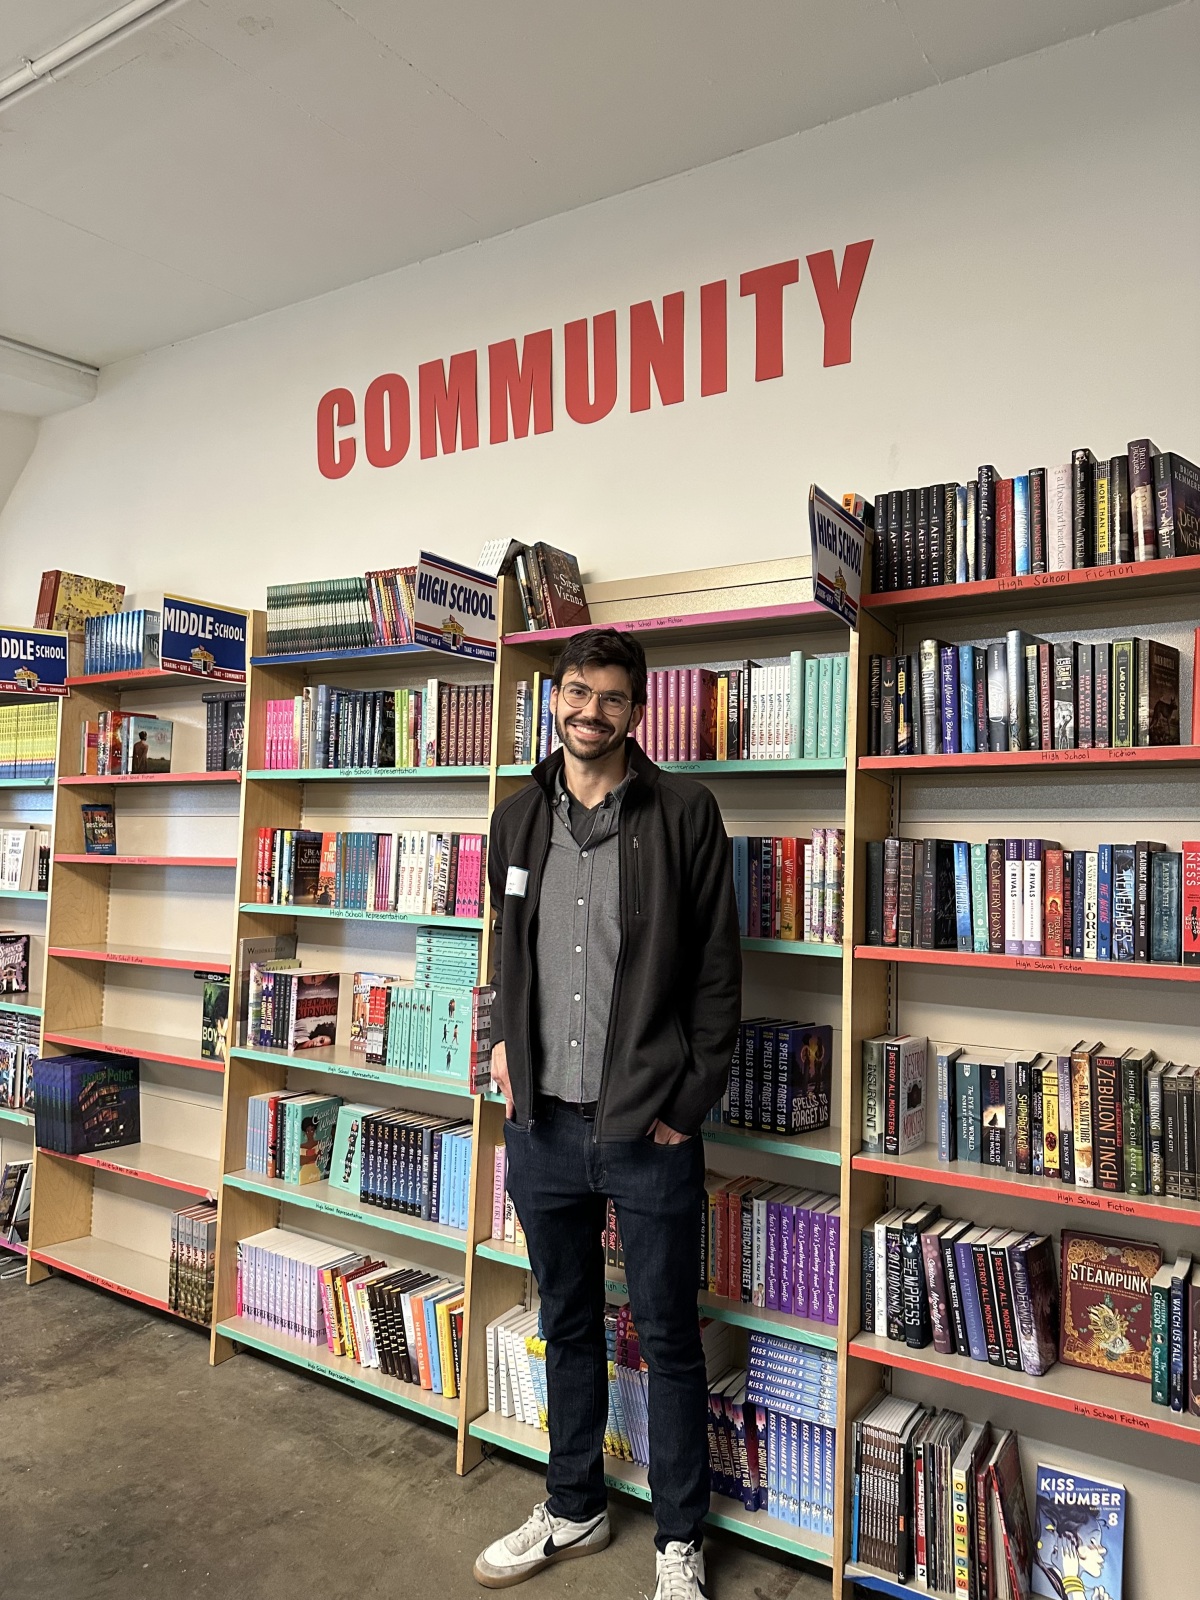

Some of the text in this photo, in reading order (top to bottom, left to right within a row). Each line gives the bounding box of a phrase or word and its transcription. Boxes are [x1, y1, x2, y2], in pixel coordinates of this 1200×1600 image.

[317, 239, 874, 479] COMMUNITY
[1033, 477, 1041, 509] DESTROY
[1174, 471, 1200, 491] KEMMERE
[1057, 482, 1066, 524] thousand
[817, 511, 837, 556] HIGH
[1057, 525, 1066, 569] heartbeats
[559, 574, 580, 593] Siege
[998, 565, 1134, 590] High School Fiction
[418, 572, 495, 620] HIGH SCHOOL
[554, 584, 584, 607] Vienna
[164, 607, 244, 641] MIDDLE SCHOOL
[2, 637, 65, 660] DDLE SCHOOL
[516, 704, 525, 717] ARE
[515, 719, 524, 735] NOT
[1042, 752, 1059, 760] High
[1065, 752, 1090, 760] School
[1138, 851, 1147, 901] DEADBEAT DRUID
[1186, 852, 1196, 886] NESS
[991, 913, 1001, 939] BOYS
[1086, 902, 1096, 949] FORGE
[1016, 958, 1082, 972] High School Fiction
[107, 1068, 134, 1083] Potter
[777, 1043, 788, 1125] SPELLS TO FORGET US
[792, 1093, 828, 1111] SPELLS TO
[867, 1064, 877, 1130] INSURGENT
[792, 1107, 828, 1128] FORGET US
[1017, 1094, 1028, 1149] SHIP BREAKER
[1080, 1100, 1091, 1144] SALVATORE
[1097, 1067, 1118, 1182] ZEBULON FINCH
[1057, 1193, 1135, 1213] High School Fiction
[742, 1212, 752, 1289] AMERICAN STREET
[904, 1268, 920, 1326] EMPRESS
[977, 1253, 996, 1343] DESTROY ALL MONSTERS
[1153, 1291, 1163, 1331] GREGORY
[1172, 1299, 1181, 1326] WATCH
[1173, 1329, 1180, 1341] US
[751, 1346, 766, 1355] KISS
[768, 1351, 798, 1364] NUMBER
[748, 1394, 763, 1403] KISS
[765, 1399, 795, 1412] NUMBER
[1074, 1404, 1150, 1428] High School Fiction
[1041, 1478, 1075, 1491] KISS
[1054, 1492, 1120, 1506] NUMBER
[1108, 1512, 1118, 1526] 8
[956, 1482, 967, 1589] CHOPSTICKS
